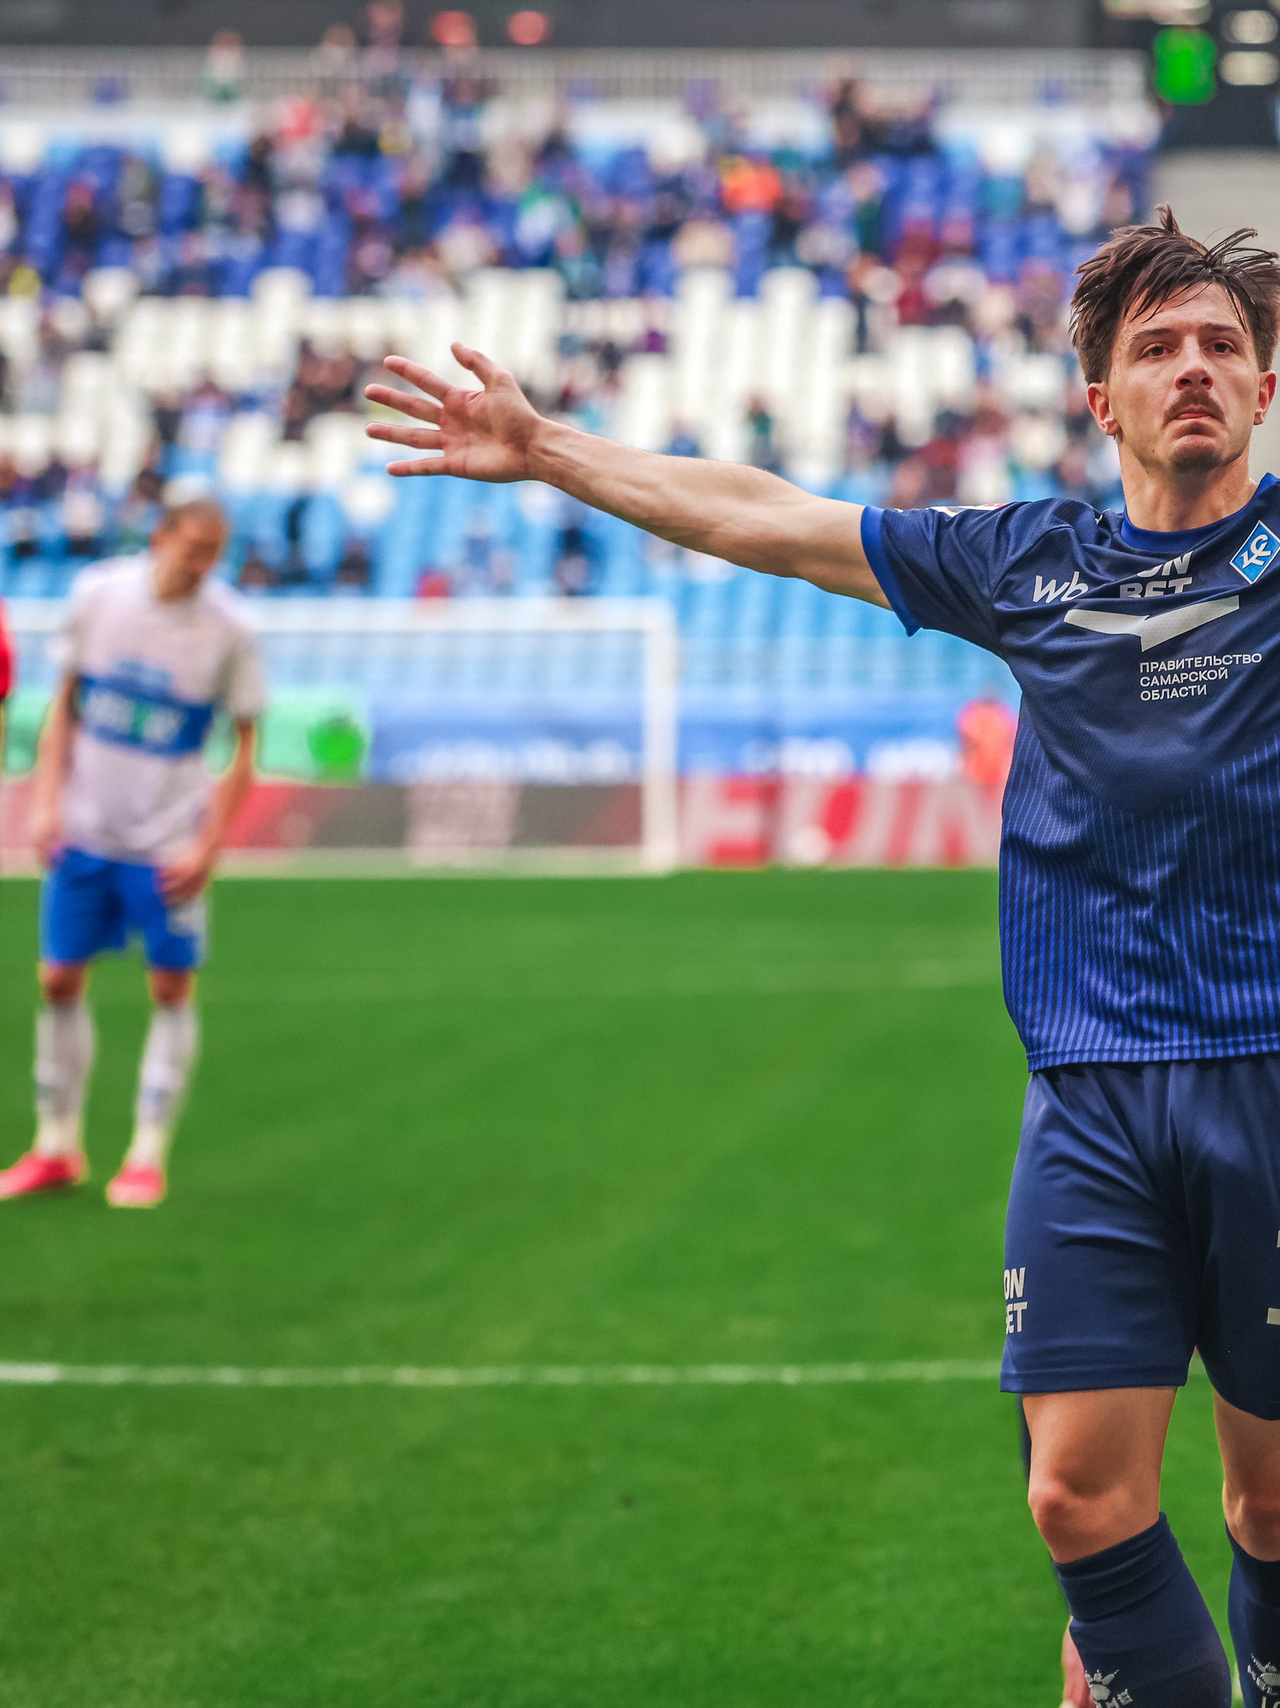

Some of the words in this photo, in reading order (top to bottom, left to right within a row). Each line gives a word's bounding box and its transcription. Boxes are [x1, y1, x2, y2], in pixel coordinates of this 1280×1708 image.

[1139, 653, 1262, 673] ПРАВИТЕЛЬСТВО
[1140, 667, 1228, 687] САМАРСКОЙ
[1140, 684, 1207, 701] ОБЛАСТИ
[1005, 1301, 1028, 1335] ET
